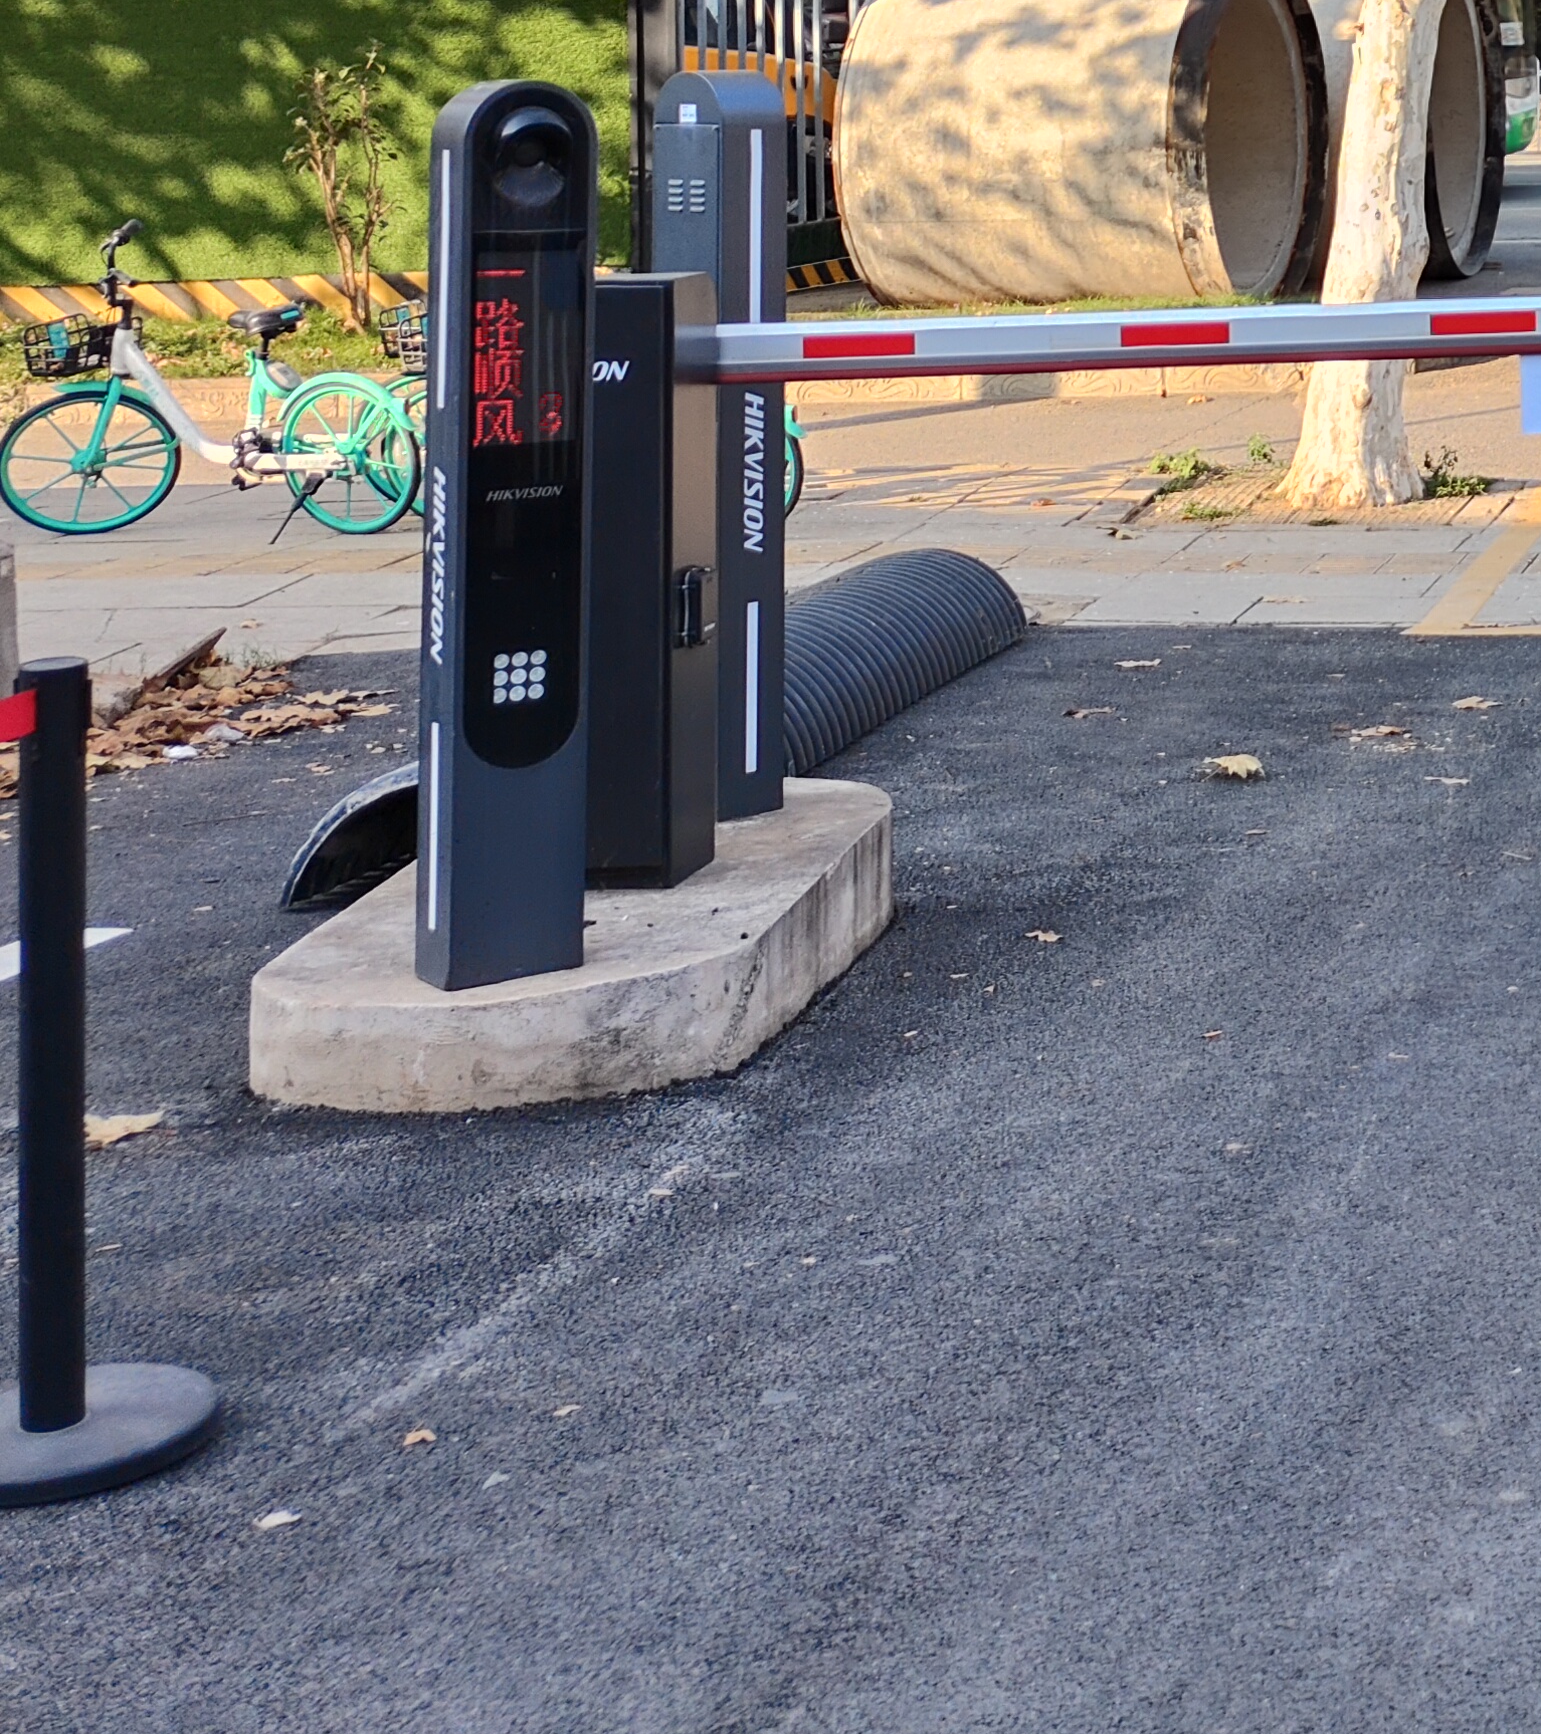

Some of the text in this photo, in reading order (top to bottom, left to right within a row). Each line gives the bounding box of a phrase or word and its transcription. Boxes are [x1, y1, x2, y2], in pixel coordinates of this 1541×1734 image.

[473, 269, 526, 448] 一路顺风
[485, 484, 564, 502] HIKVISION
[743, 391, 765, 554] HIKVISION
[430, 466, 446, 665] HIKVISION
